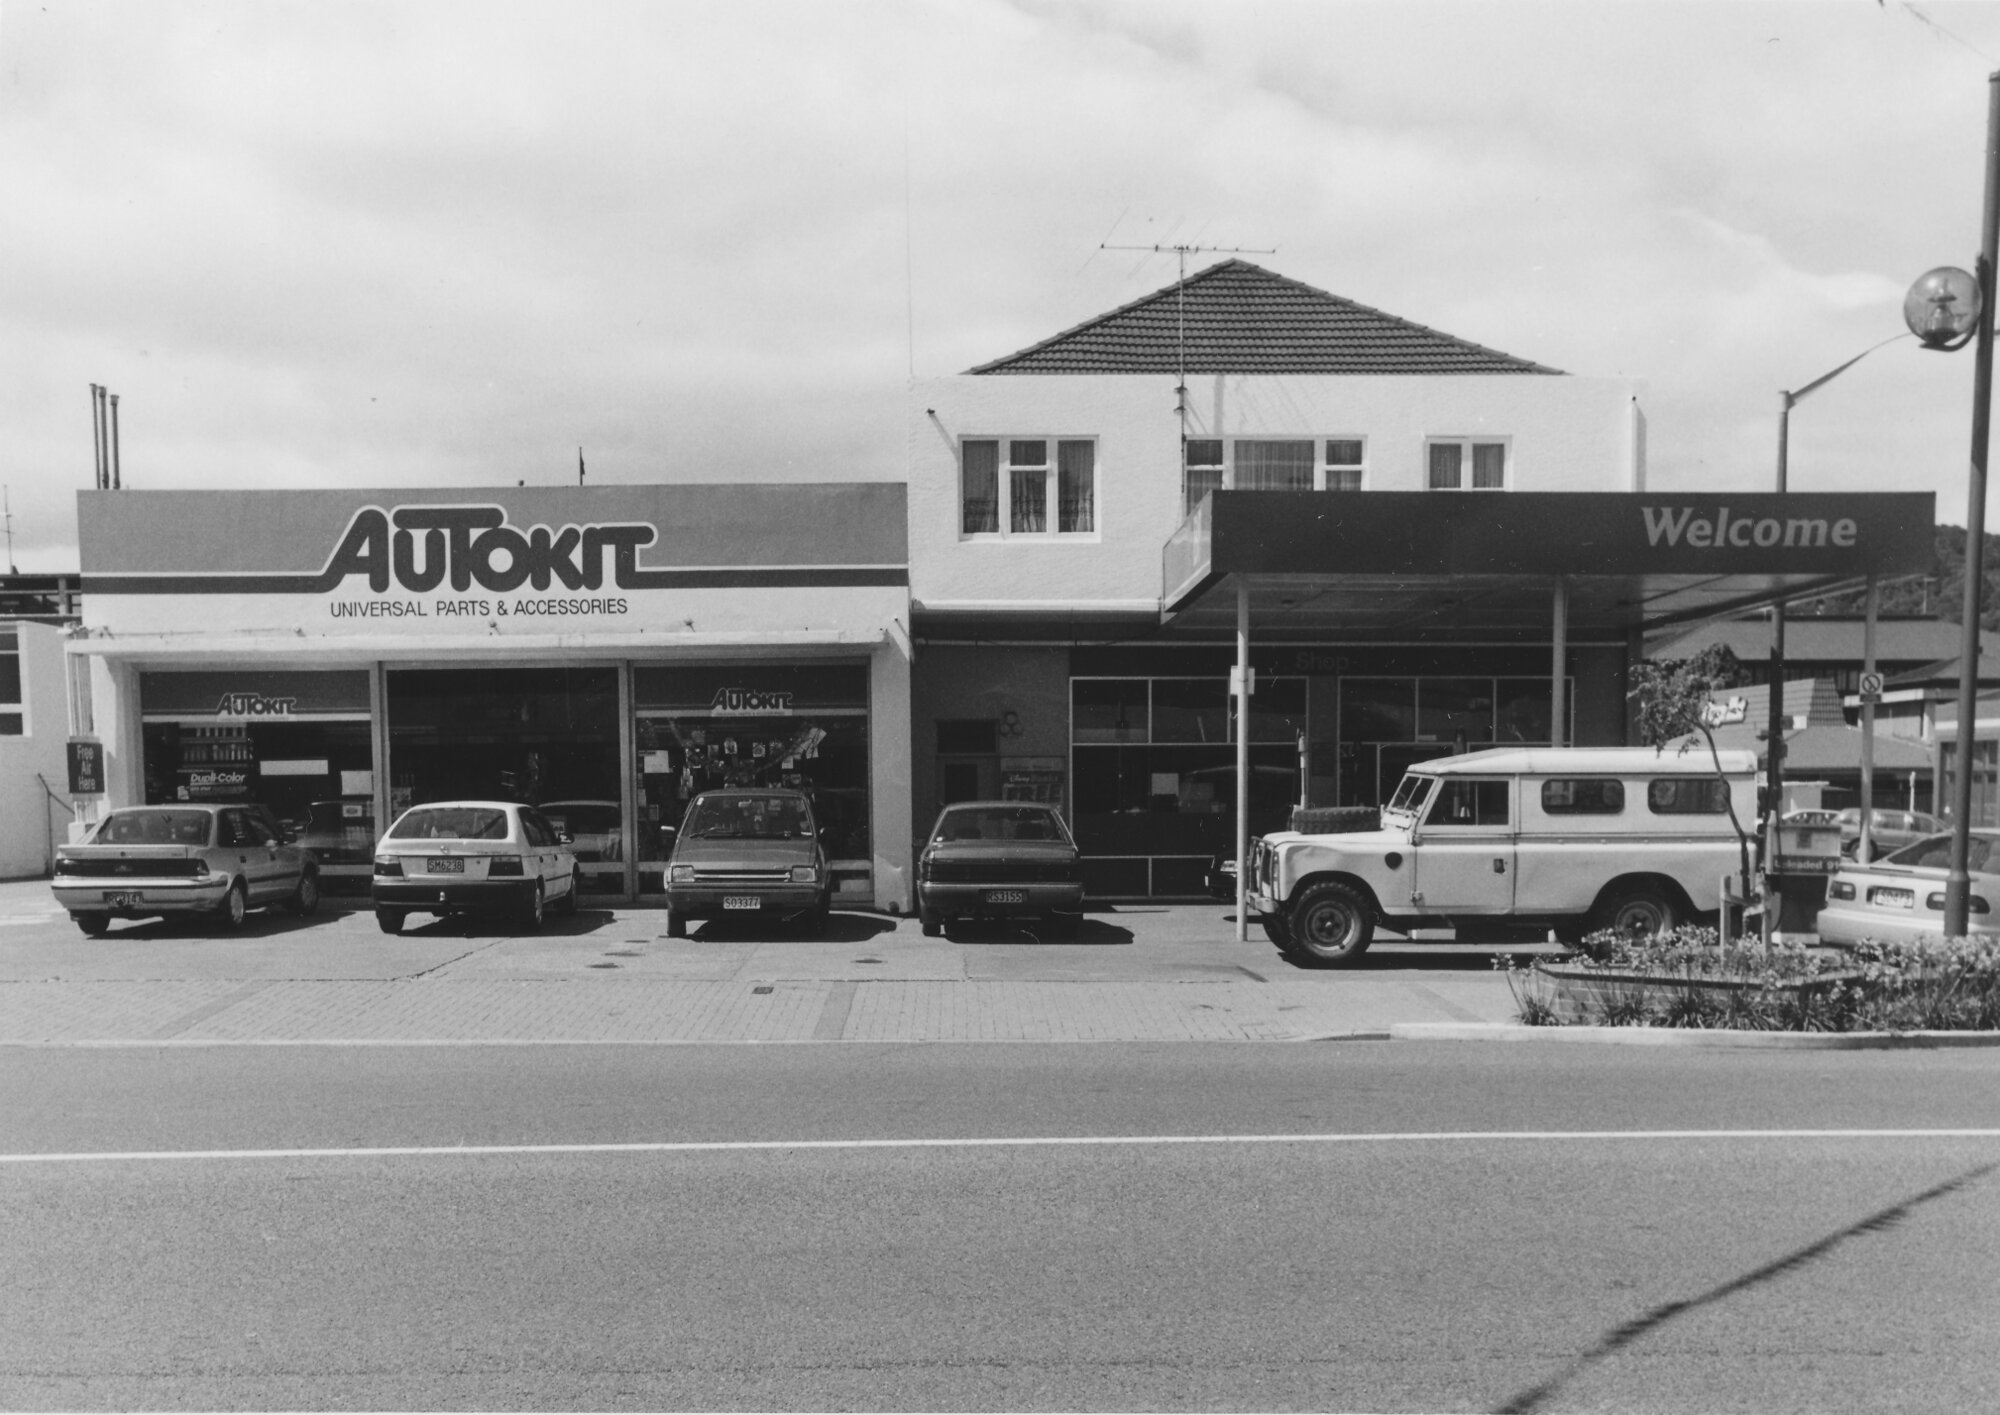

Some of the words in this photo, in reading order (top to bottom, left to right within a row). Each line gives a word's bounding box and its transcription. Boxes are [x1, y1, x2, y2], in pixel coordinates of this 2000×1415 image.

[1641, 506, 1858, 547] Welcome
[326, 503, 657, 594] AUTOKIT
[330, 601, 428, 618] UNIVERSAL
[436, 600, 490, 617] PARTS
[496, 600, 509, 616] &
[513, 598, 629, 616] ACCESSORIES
[1296, 651, 1349, 675] Shop
[216, 692, 297, 716] AUTOKIT
[711, 688, 793, 711] AUTOKIT
[77, 744, 94, 760] Free
[81, 760, 92, 775] Air
[190, 772, 247, 784] Dupli-Color
[78, 775, 96, 791] Here
